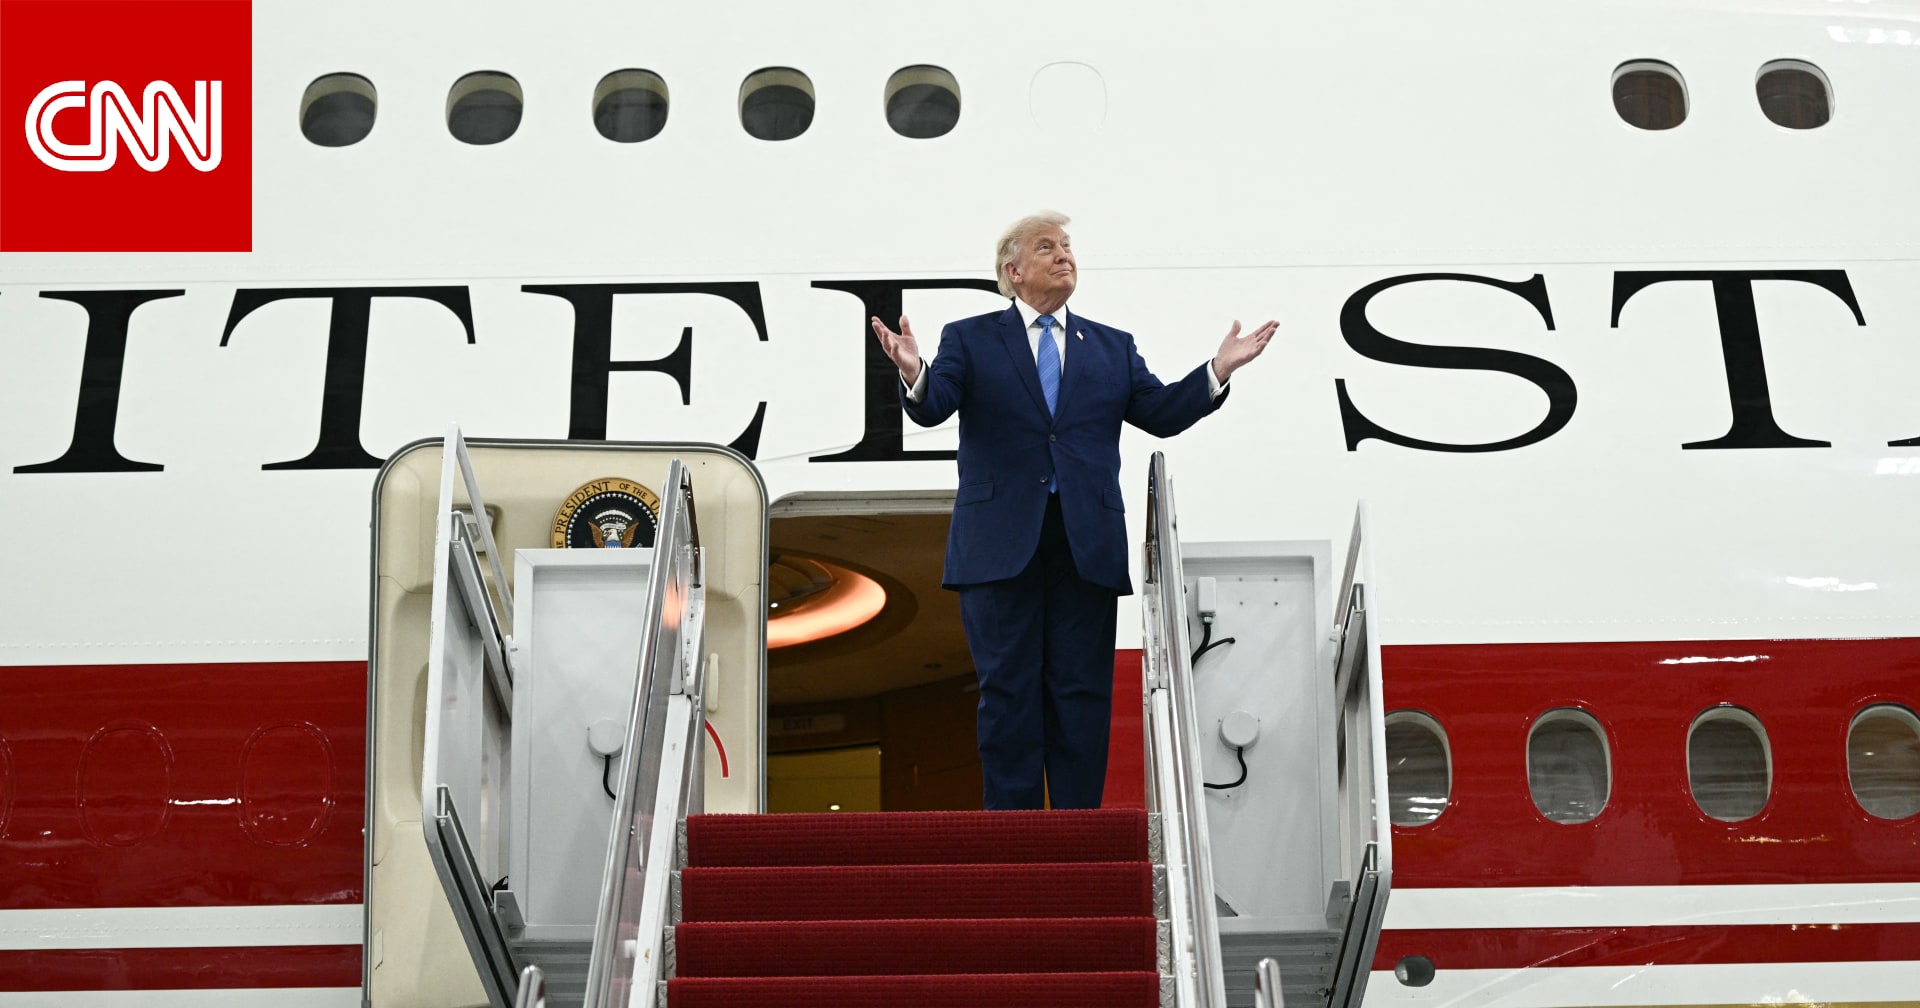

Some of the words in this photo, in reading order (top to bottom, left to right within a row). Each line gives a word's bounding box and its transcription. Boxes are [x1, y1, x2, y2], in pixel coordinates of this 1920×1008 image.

[0, 279, 1015, 473] ITED
[1335, 270, 1920, 453] ST
[555, 481, 610, 534] PRESIDENT
[632, 487, 648, 499] THE
[650, 500, 660, 515] U
[783, 718, 814, 730] EXIT
